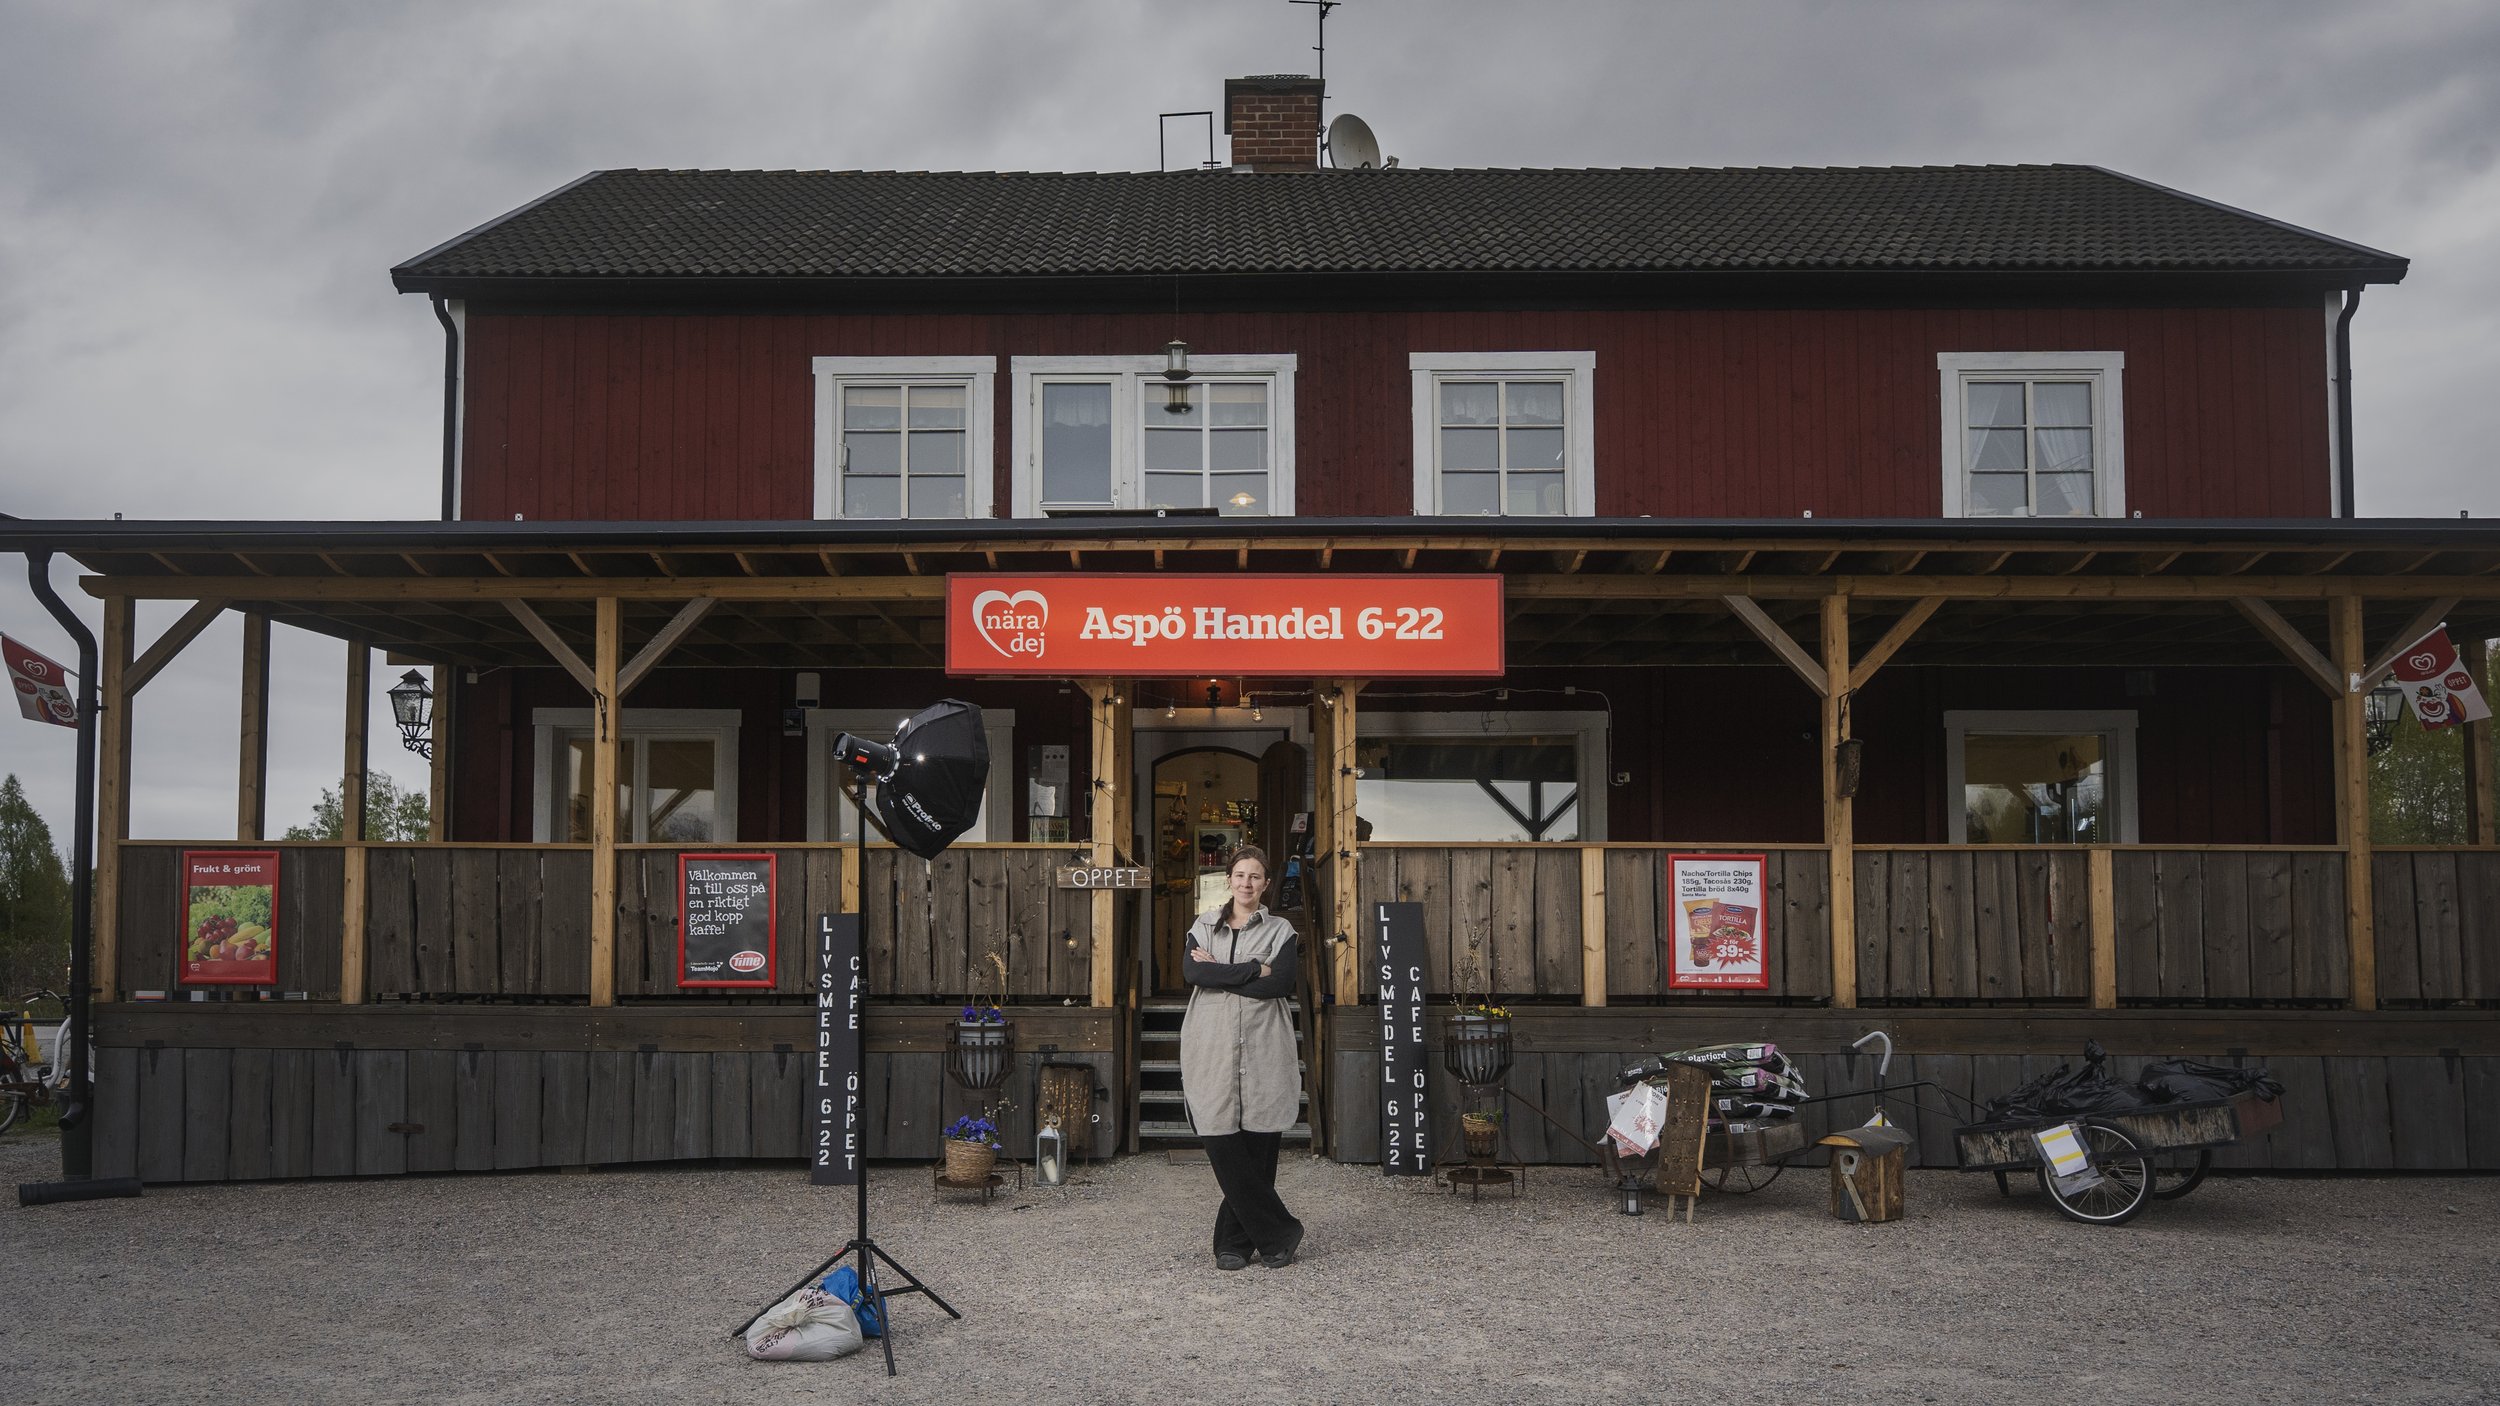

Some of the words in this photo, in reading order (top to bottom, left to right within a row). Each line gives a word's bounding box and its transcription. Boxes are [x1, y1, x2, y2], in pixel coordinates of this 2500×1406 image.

[985, 609, 1040, 631] nära
[1080, 606, 1186, 647] Aspö
[1193, 607, 1343, 640] Handel
[1357, 607, 1443, 640] 6-22
[1010, 631, 1045, 659] dej
[193, 865, 219, 873] Frukt
[222, 864, 231, 873] &
[234, 864, 261, 874] grönt
[688, 870, 757, 881] Välkommen
[688, 884, 701, 895] in
[704, 883, 723, 895] till
[726, 884, 748, 894] oss
[751, 882, 766, 897] på
[1682, 878, 1701, 886] 185g,
[1726, 885, 1749, 893] 8x40g
[688, 900, 704, 909] en
[708, 895, 750, 910] riktigt
[689, 910, 711, 925] god
[715, 910, 743, 925] kopp
[689, 924, 725, 936] kaffe!
[1716, 944, 1750, 958] 39:-
[819, 916, 833, 1087] LIVSMEDEL
[1379, 905, 1396, 1084] LIVSMEDEL
[1409, 966, 1423, 1043] CAFE
[845, 1071, 858, 1171] ÖPPET
[1412, 1068, 1425, 1171] ÖPPET
[818, 1098, 831, 1167] 6-22
[1387, 1100, 1400, 1167] 6-22
